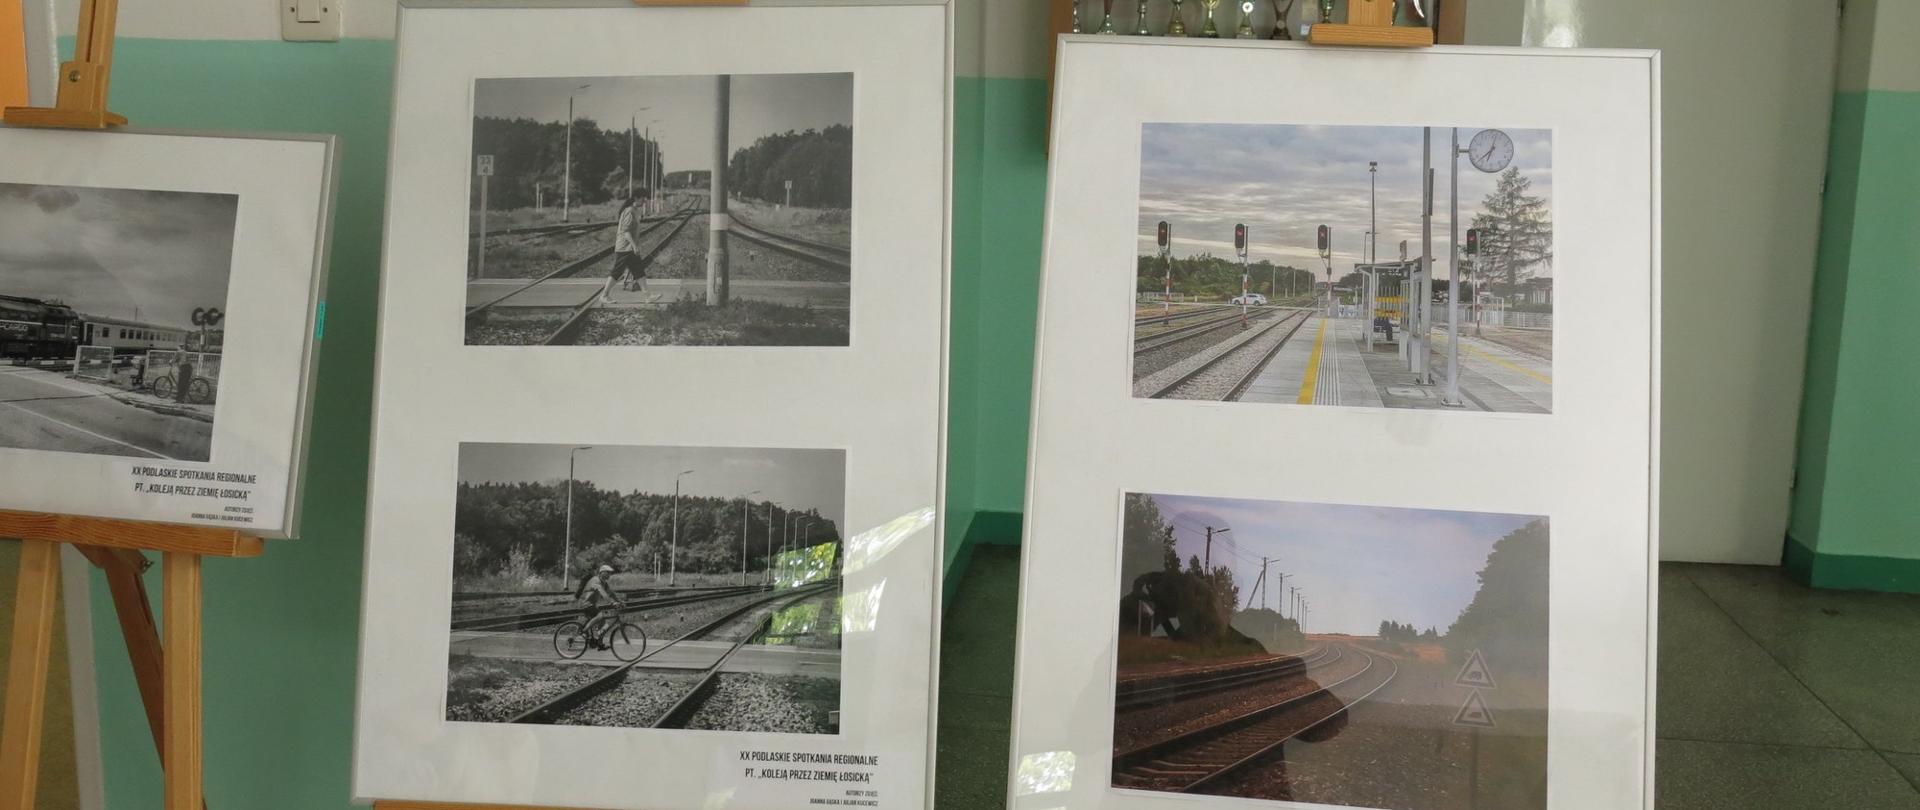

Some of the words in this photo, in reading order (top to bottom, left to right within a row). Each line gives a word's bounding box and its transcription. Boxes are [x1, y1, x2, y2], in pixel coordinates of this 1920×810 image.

[131, 466, 141, 475] XX
[142, 466, 178, 478] PODLASKIE
[179, 469, 215, 481] SPOTKANIA
[216, 472, 257, 484] REGIONALNE
[134, 482, 145, 492] PT.
[175, 486, 196, 496] PRZEZ
[196, 487, 219, 499] ZIEMIĘ
[740, 751, 750, 761] XX
[752, 751, 791, 763] PODLASKIE
[792, 753, 832, 764] SPOTKANIA
[834, 754, 878, 766] REGIONALNE
[745, 768, 756, 778] PT.
[789, 770, 812, 780] PRZEZ
[813, 771, 838, 783] ZIEMIĘ
